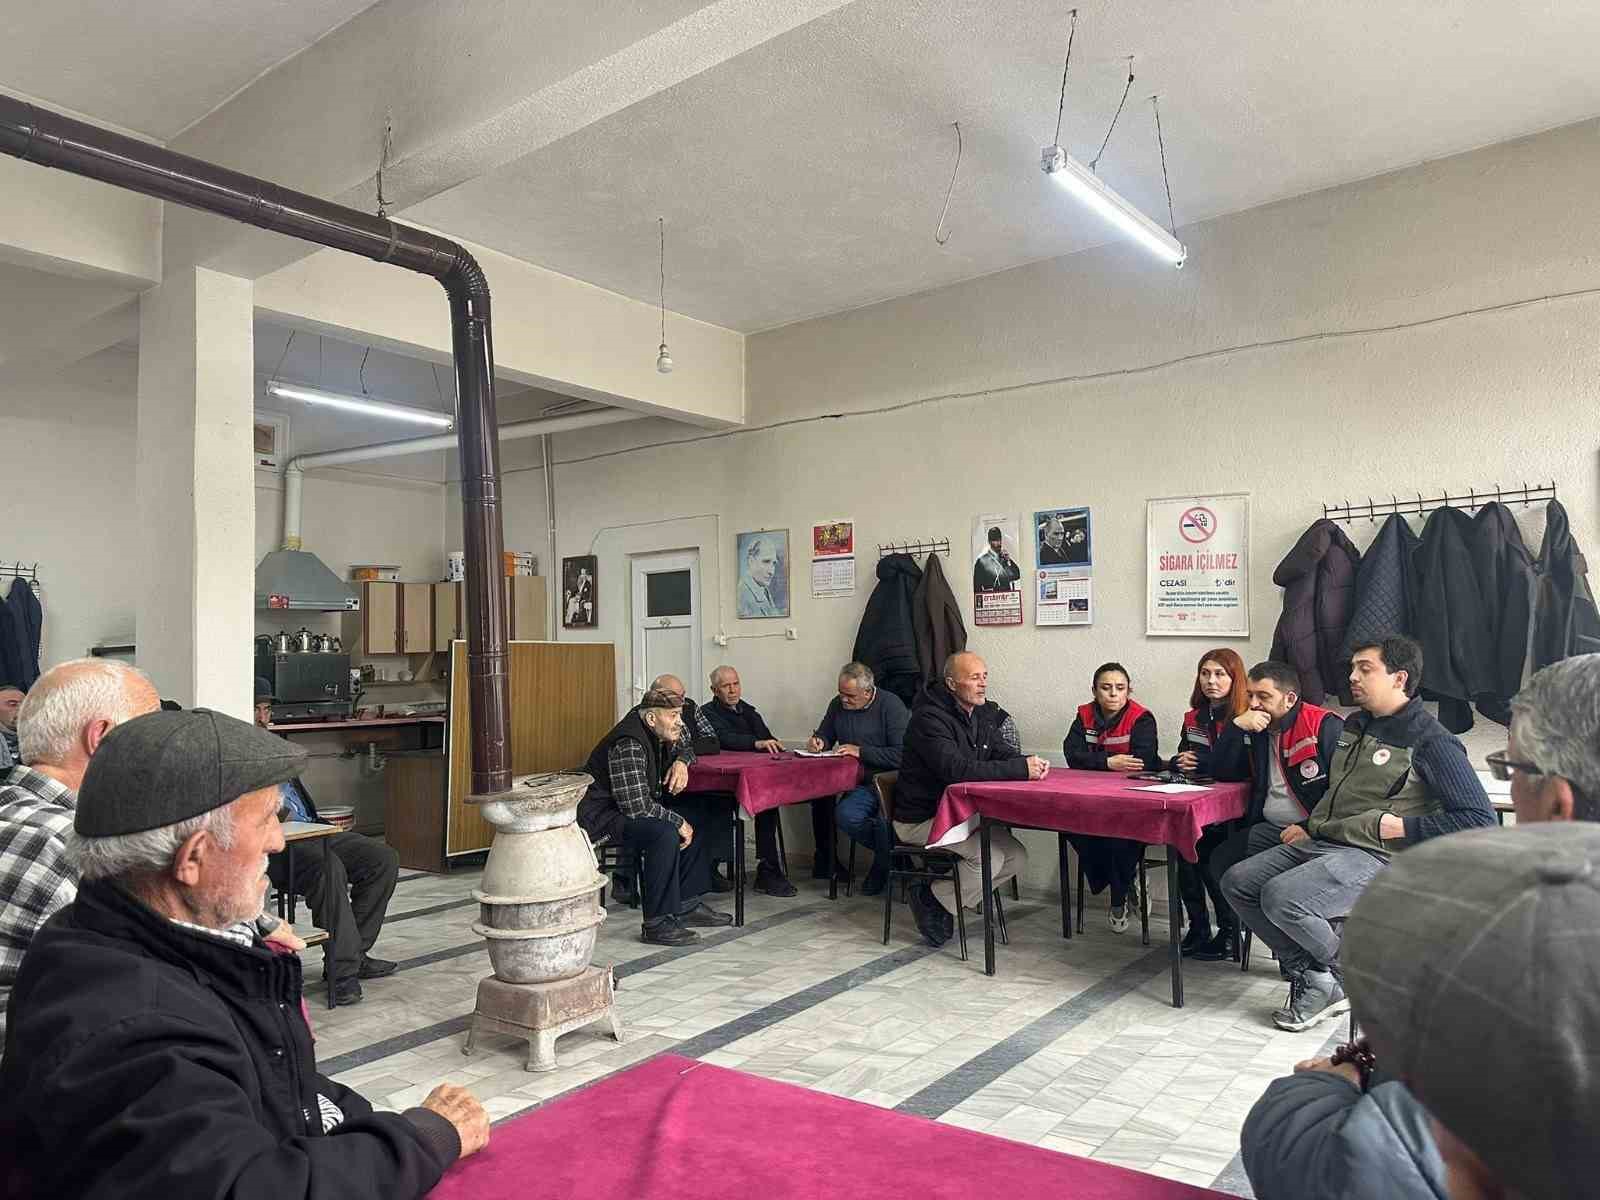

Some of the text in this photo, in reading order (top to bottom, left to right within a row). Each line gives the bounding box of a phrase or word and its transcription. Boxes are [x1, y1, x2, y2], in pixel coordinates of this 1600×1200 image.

[1159, 549, 1238, 574] SİGARA İÇİLMEZ
[1159, 579, 1187, 587] CEZASI
